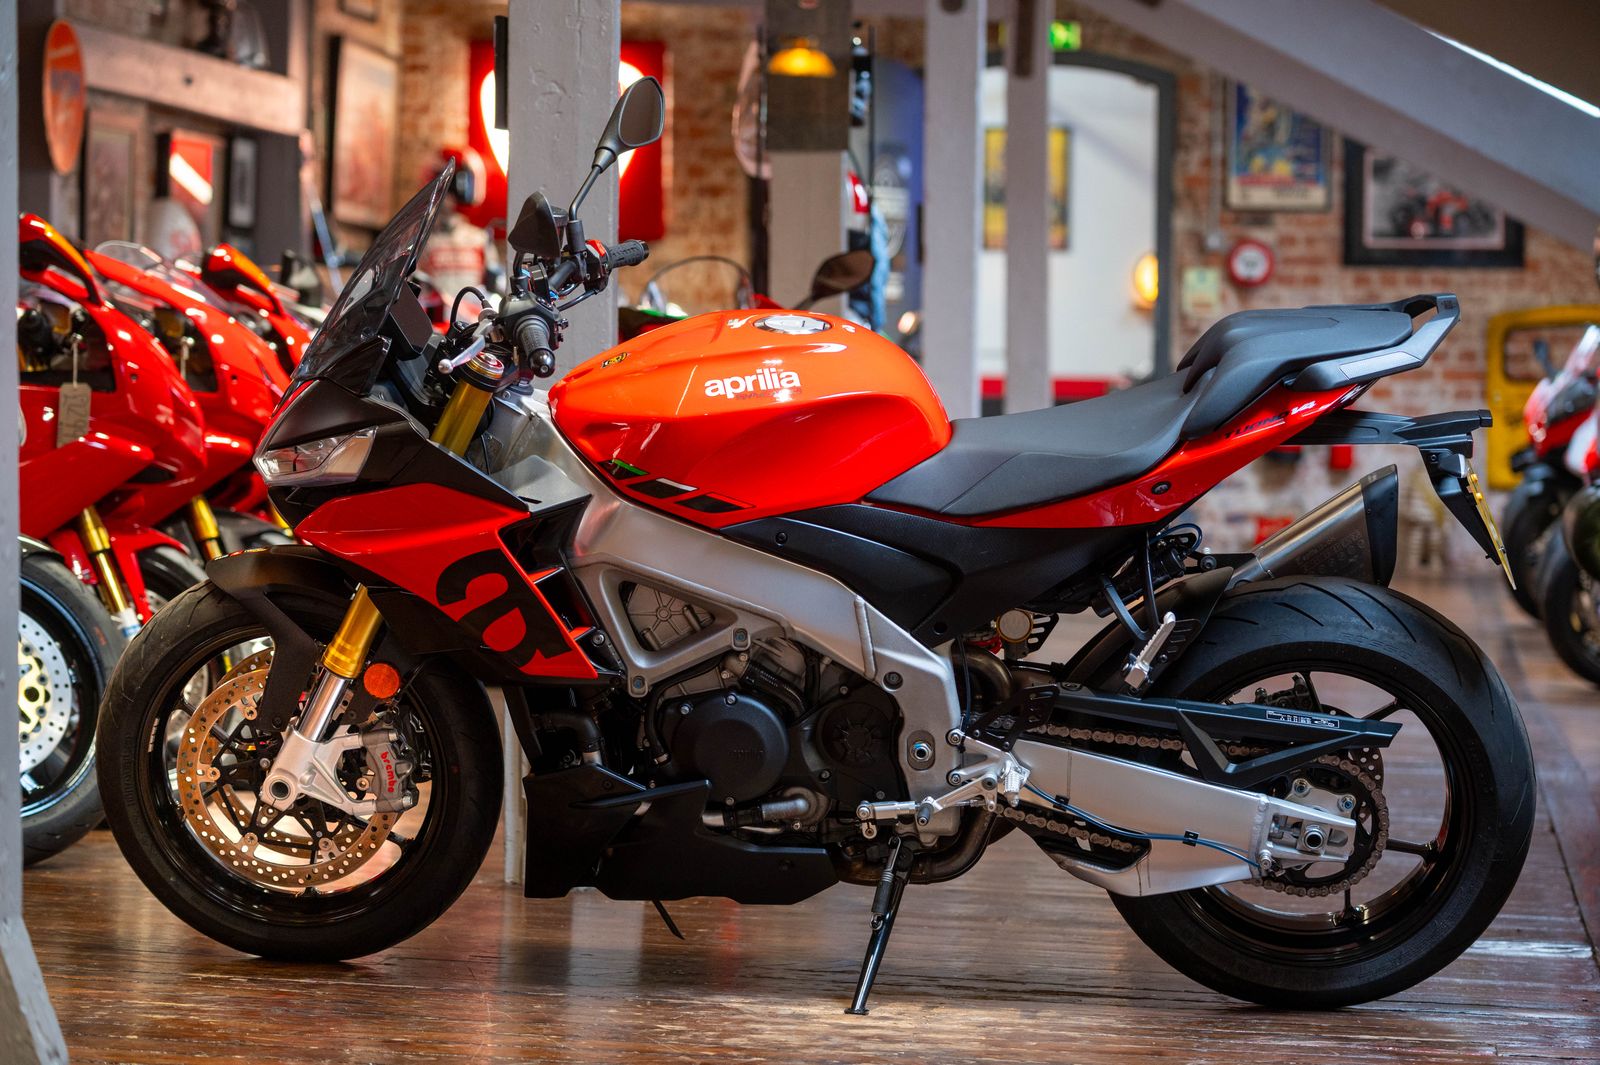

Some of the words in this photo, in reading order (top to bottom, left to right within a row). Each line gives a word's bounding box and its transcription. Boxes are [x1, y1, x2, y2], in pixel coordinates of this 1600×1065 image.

[703, 367, 801, 399] aprilia
[1224, 411, 1290, 439] TUONO
[381, 751, 397, 793] brembo
